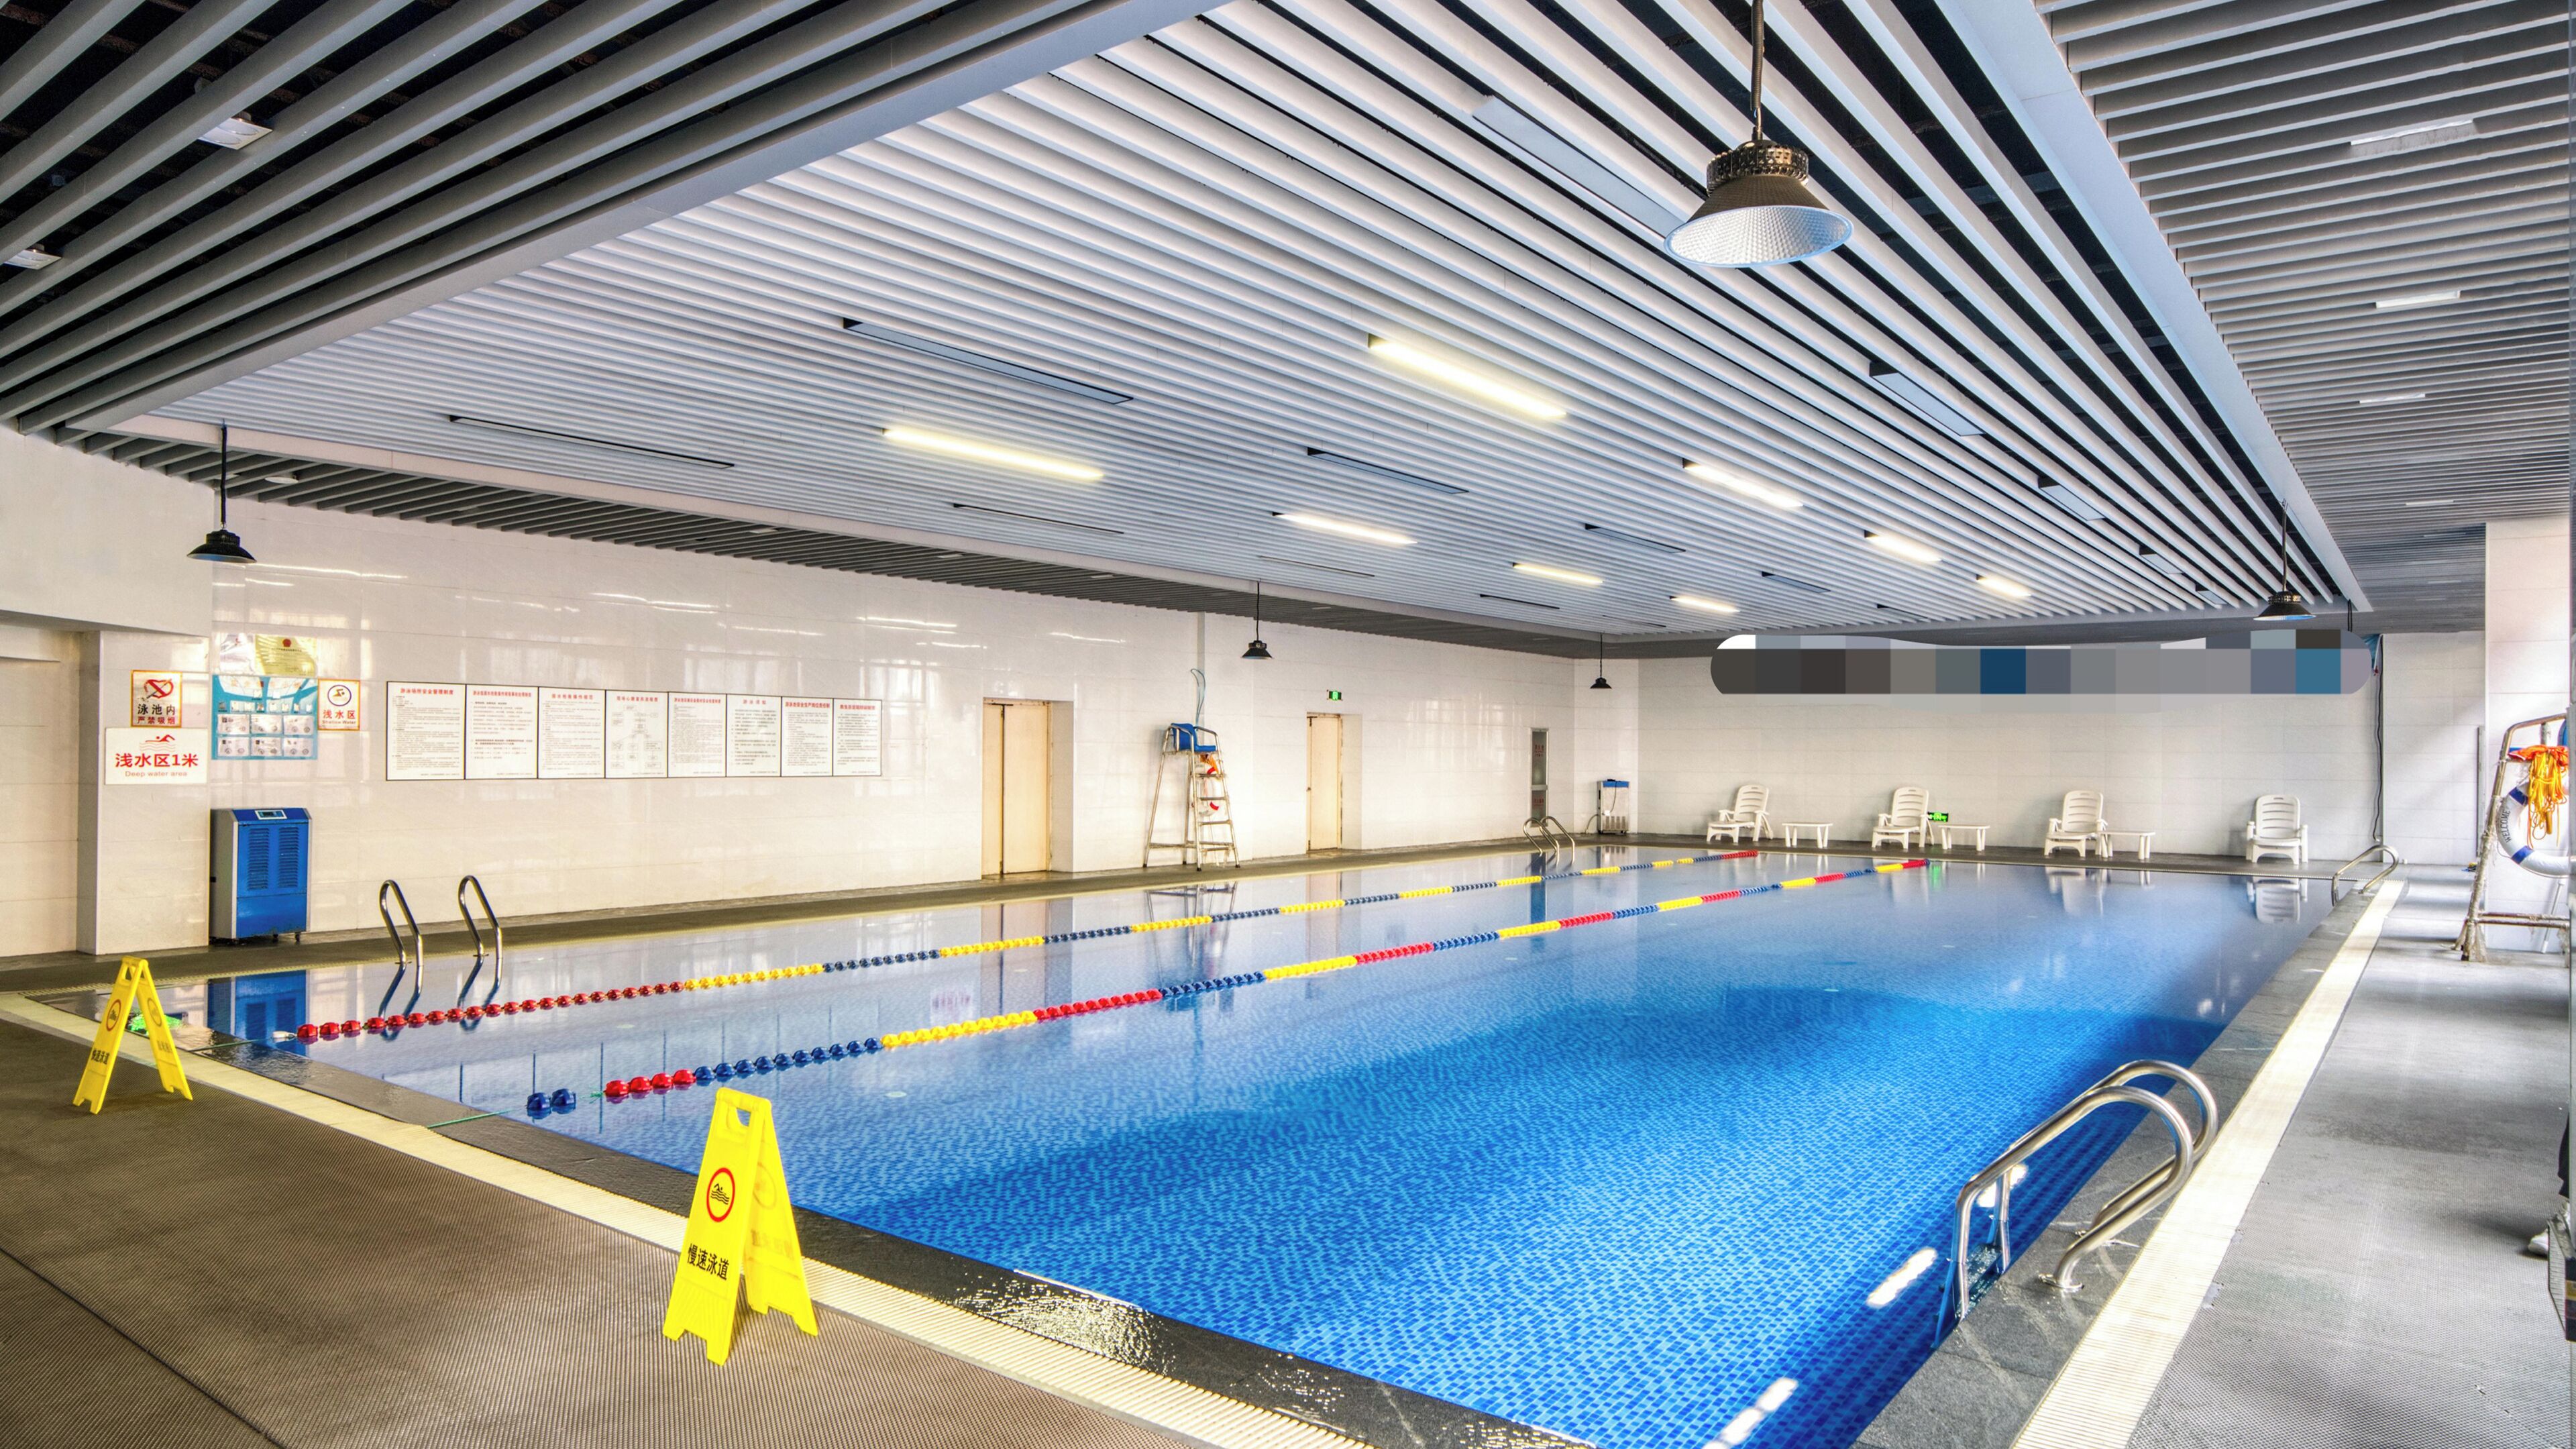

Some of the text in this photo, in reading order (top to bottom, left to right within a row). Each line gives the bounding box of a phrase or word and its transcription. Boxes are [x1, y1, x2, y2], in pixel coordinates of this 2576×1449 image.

[138, 704, 175, 715] 泳池内
[323, 709, 356, 719] 浅水区
[137, 716, 175, 724] 严禁吸烟
[115, 753, 199, 767] 浅水区1米
[2500, 809, 2512, 843] WELCOME
[686, 1242, 729, 1281] 慢速泳道
